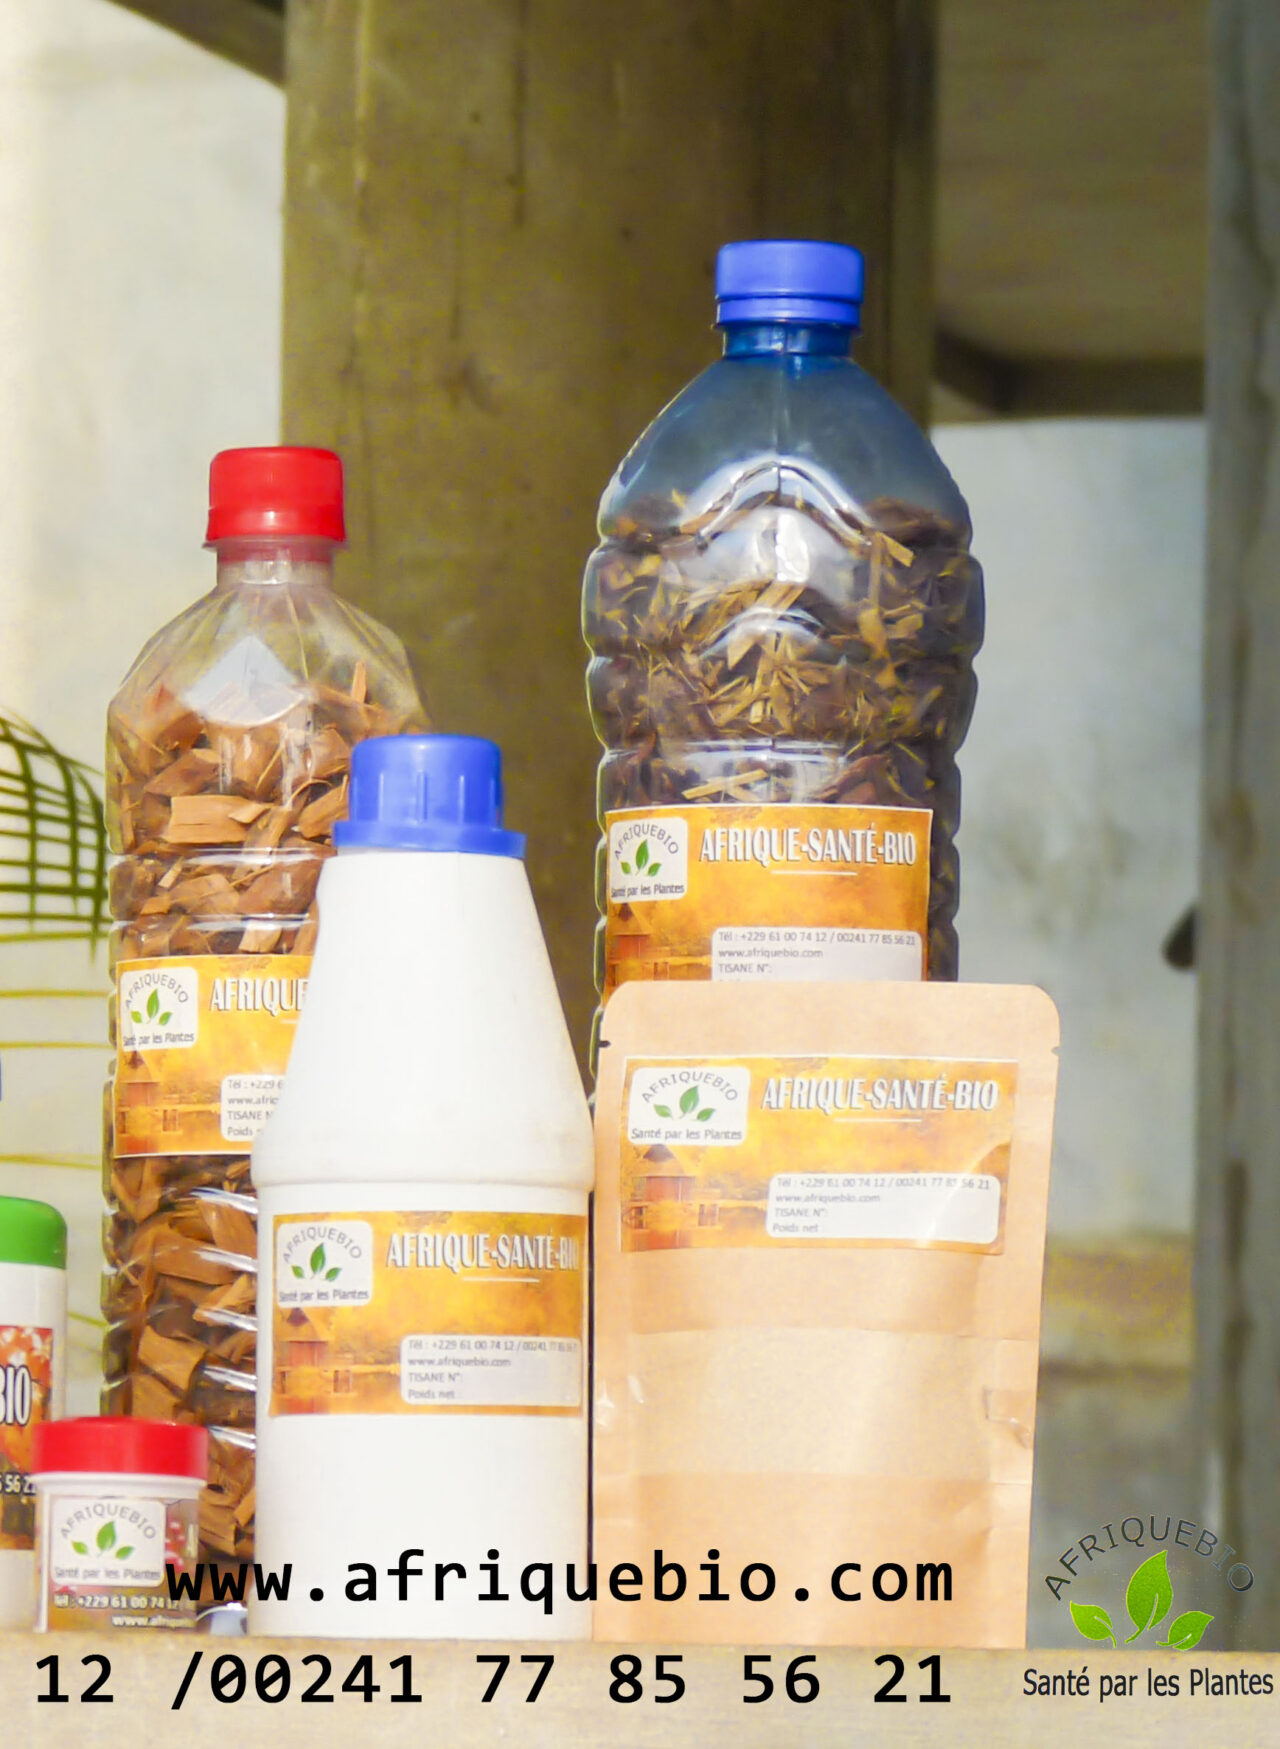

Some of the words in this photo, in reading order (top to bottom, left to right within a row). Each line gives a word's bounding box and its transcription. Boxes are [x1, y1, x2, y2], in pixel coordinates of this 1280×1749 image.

[614, 823, 679, 861] AFRIQUEBIO
[700, 821, 917, 868] AFRIQUE-SANTÉ-BIO
[654, 882, 685, 895] Plantes
[741, 931, 766, 942] +229
[769, 931, 780, 942] 61
[783, 932, 797, 942] 00
[800, 932, 812, 942] 74
[816, 932, 827, 942] 12
[836, 932, 866, 943] 00241
[869, 934, 880, 943] 77
[718, 947, 824, 958] www.afriquebio.com
[719, 963, 753, 973] TISANE
[125, 973, 189, 1009] AFRIQUEBIO
[209, 977, 309, 1017] AFRIQUE
[165, 1032, 195, 1043] Plantes
[641, 1070, 739, 1103] AFRIQUEBIO
[761, 1072, 1000, 1116] AFRIQUE-SANTÉ-BIO
[227, 1109, 262, 1121] TISANE
[227, 1126, 253, 1137] Poids
[631, 1127, 661, 1140] Santé
[665, 1129, 682, 1140] par
[686, 1128, 700, 1140] les
[704, 1128, 742, 1140] Plantes
[800, 1178, 825, 1188] +229
[842, 1178, 856, 1188] 00
[859, 1178, 871, 1188] 74
[874, 1178, 886, 1188] 12
[896, 1178, 927, 1188] 00241
[932, 1177, 943, 1187] 77
[961, 1178, 975, 1189] 56
[978, 1179, 990, 1190] 21
[775, 1193, 881, 1204] www.afriquebio.com
[775, 1207, 809, 1217] TISANE
[283, 1226, 362, 1263] AFRIQUEBIO
[387, 1226, 579, 1274] AFRIQUE-SANTÉ-BIO
[317, 1289, 329, 1301] les
[332, 1288, 369, 1300] Plantes
[432, 1340, 457, 1350] +229
[459, 1340, 471, 1350] 61
[474, 1340, 488, 1350] 00
[490, 1340, 501, 1350] 74
[504, 1341, 514, 1351] 12
[408, 1356, 512, 1368] www.afriquebio.com
[408, 1389, 435, 1400] Poids
[5, 1474, 20, 1494] 56
[60, 1503, 157, 1540] AFRIQUEBIO
[82, 1568, 99, 1580] par
[123, 1568, 161, 1580] Plantes
[111, 1595, 127, 1609] 61
